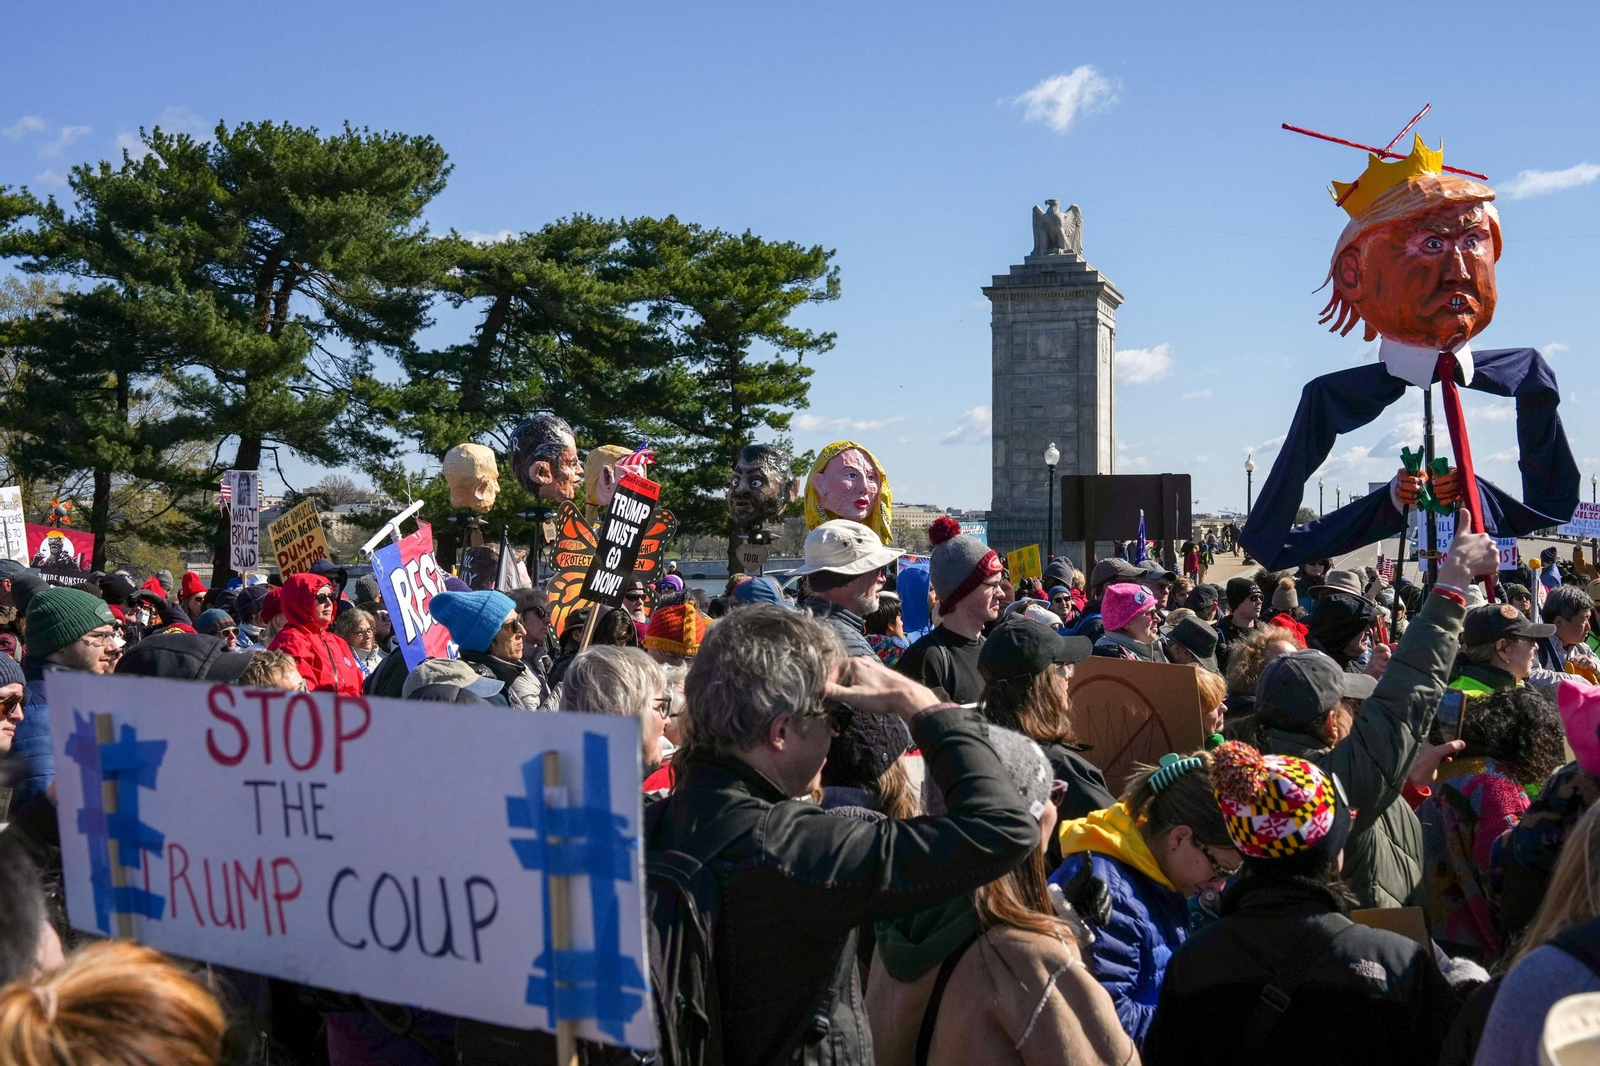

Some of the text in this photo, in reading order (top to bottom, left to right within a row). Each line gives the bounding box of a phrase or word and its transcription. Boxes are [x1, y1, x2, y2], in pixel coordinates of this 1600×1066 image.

[232, 507, 257, 523] WHAT
[611, 492, 650, 524] TRUMP
[1575, 511, 1600, 520] UBLIC
[1580, 503, 1600, 512] ORME
[231, 525, 258, 545] BRUCE
[270, 519, 291, 537] MAKE
[274, 515, 320, 551] PROUD AGAIN
[606, 519, 639, 548] MUST
[233, 547, 256, 567] SAID
[277, 535, 315, 568] DUMP
[560, 553, 592, 566] PROTECT
[605, 546, 622, 570] GO
[640, 543, 654, 554] GHT
[743, 553, 759, 562] TOOL
[282, 545, 327, 579] TRAITOR
[590, 569, 623, 597] NOW!
[205, 684, 371, 773] STOP
[244, 780, 333, 840] THE
[328, 868, 499, 963] COUP
